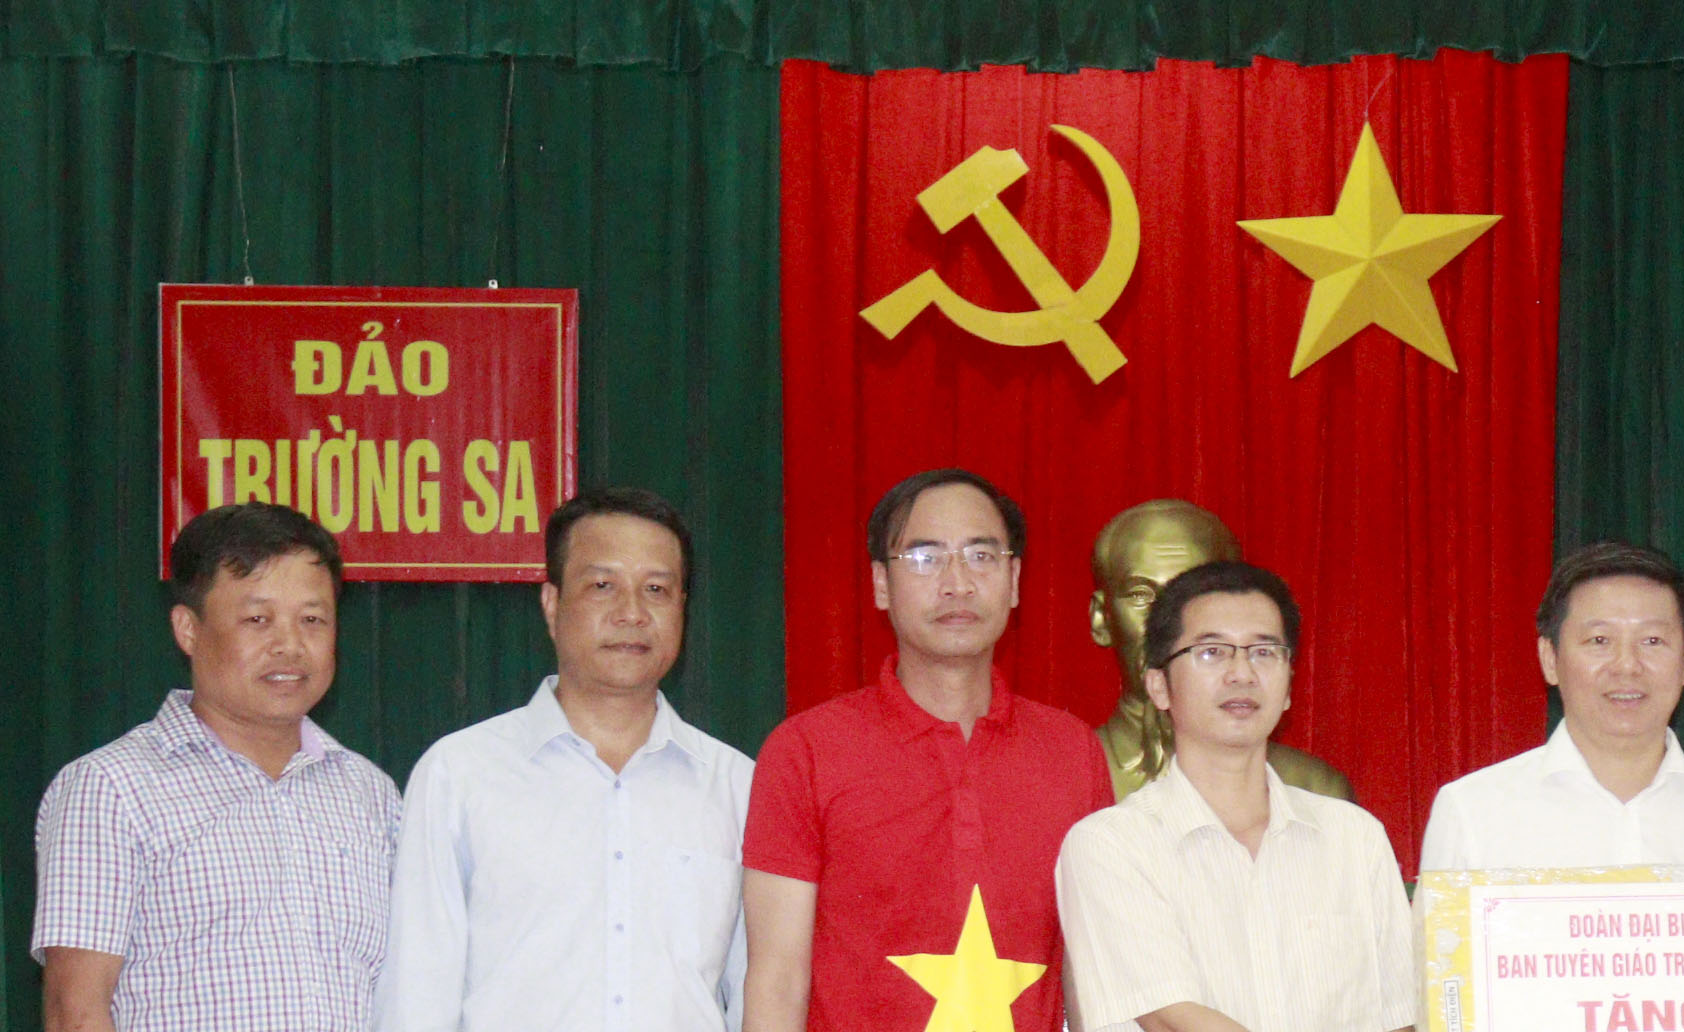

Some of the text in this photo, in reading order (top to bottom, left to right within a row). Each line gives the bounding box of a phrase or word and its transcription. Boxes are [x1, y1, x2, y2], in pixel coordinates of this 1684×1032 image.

[292, 321, 449, 396] ĐẢO
[200, 415, 540, 535] TRƯỜNG SA
[1569, 908, 1622, 938] ĐOÀN
[1629, 912, 1660, 943] ĐẠI
[1498, 953, 1537, 979] BAN
[1544, 947, 1604, 978] TUYÊN
[1612, 949, 1657, 977] GIÁO
